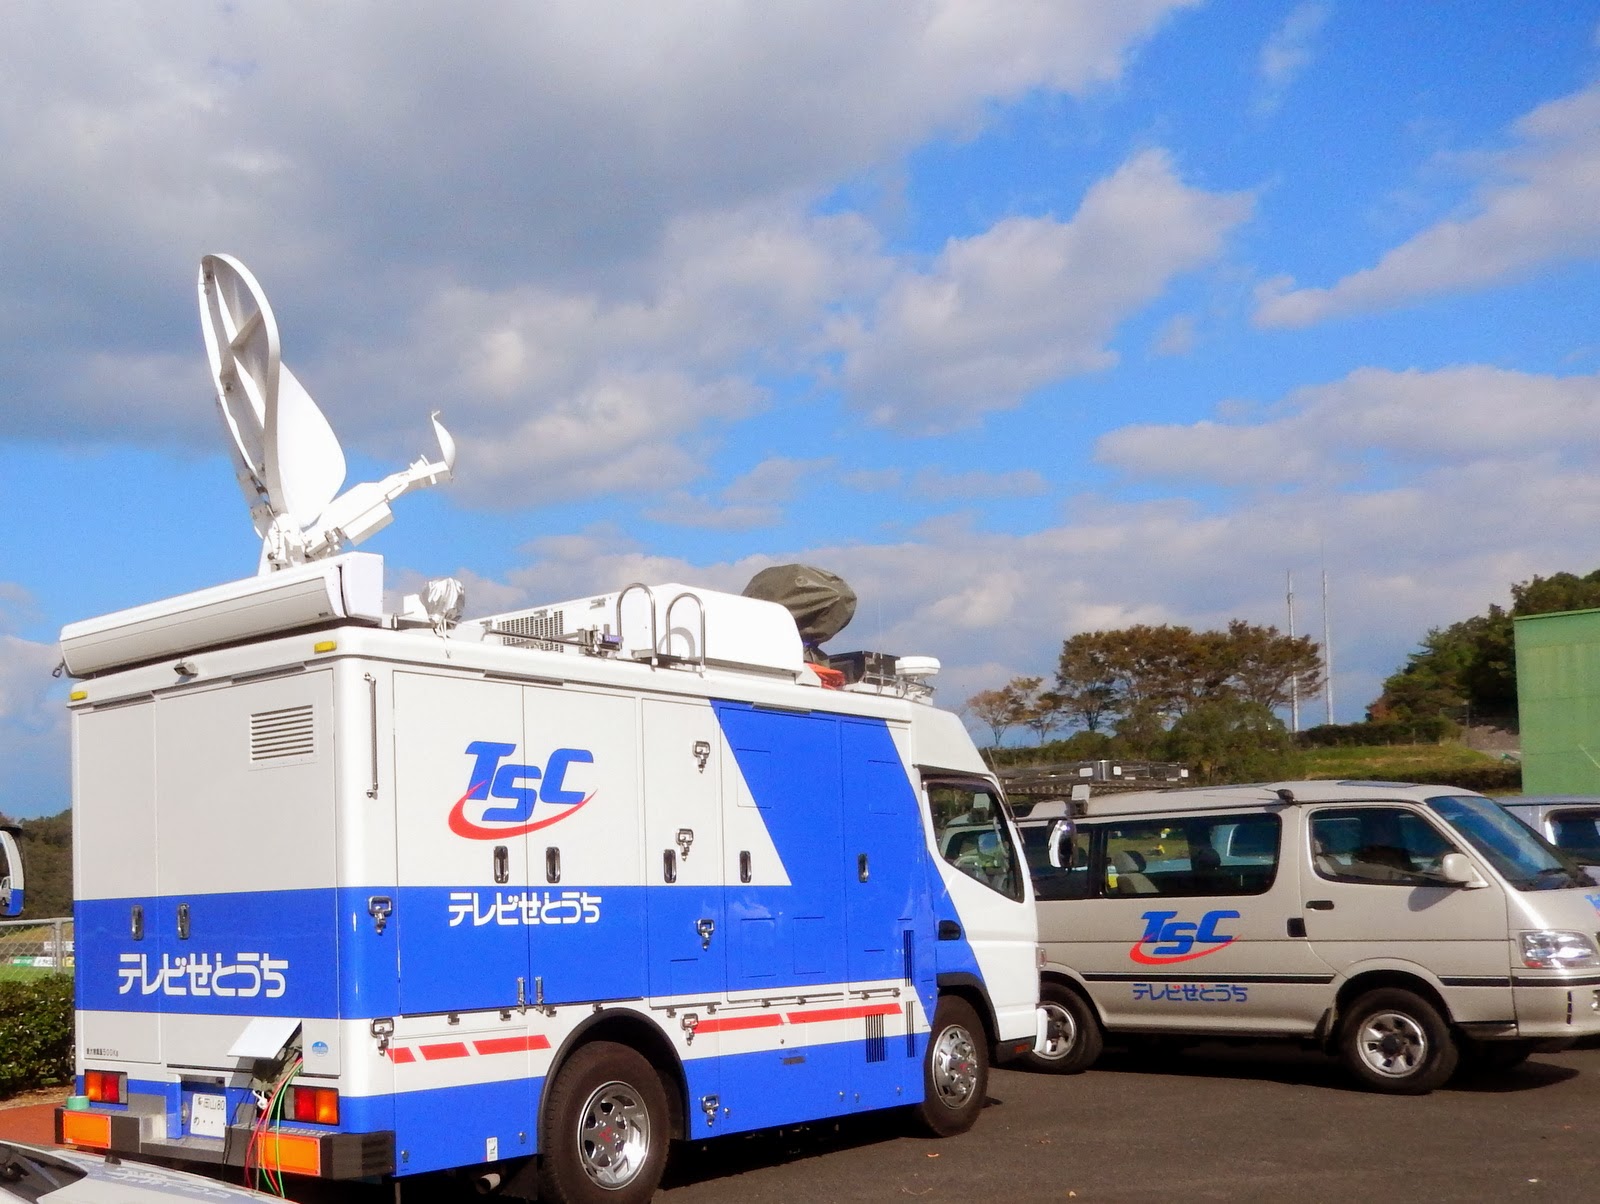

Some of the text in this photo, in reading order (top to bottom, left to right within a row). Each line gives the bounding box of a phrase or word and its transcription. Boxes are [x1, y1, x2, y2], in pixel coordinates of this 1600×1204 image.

[464, 741, 594, 822] TSC
[448, 892, 602, 927] テレビせとうち
[1141, 910, 1241, 955] TSC
[118, 952, 289, 998] テレビせとうち
[1132, 983, 1248, 1003] テレビせとうち
